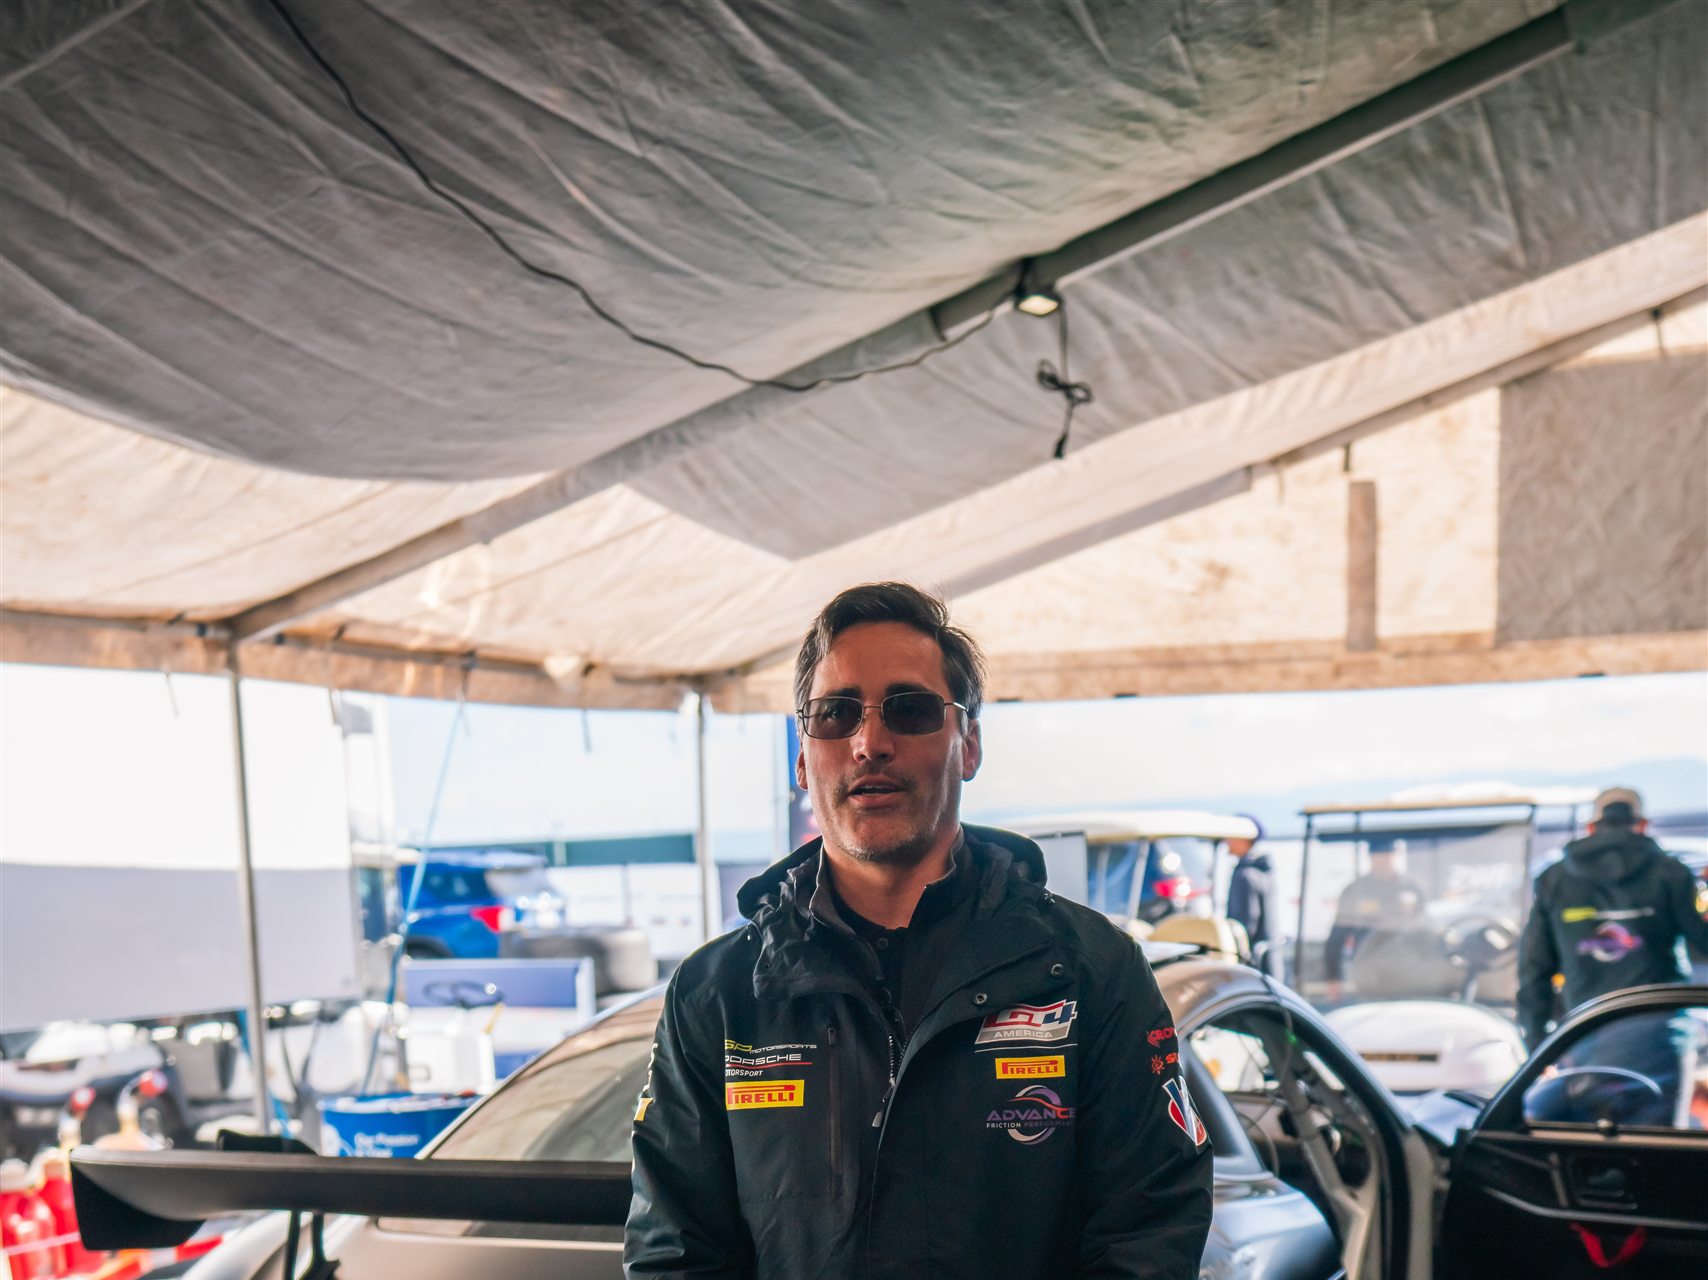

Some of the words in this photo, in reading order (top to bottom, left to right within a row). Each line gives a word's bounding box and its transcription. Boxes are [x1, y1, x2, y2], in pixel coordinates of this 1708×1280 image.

[993, 1029, 1053, 1039] AMERICA
[1001, 1060, 1059, 1075] PIRELLI
[727, 1085, 796, 1105] PIRELLI
[986, 1106, 1077, 1121] ADVANCE
